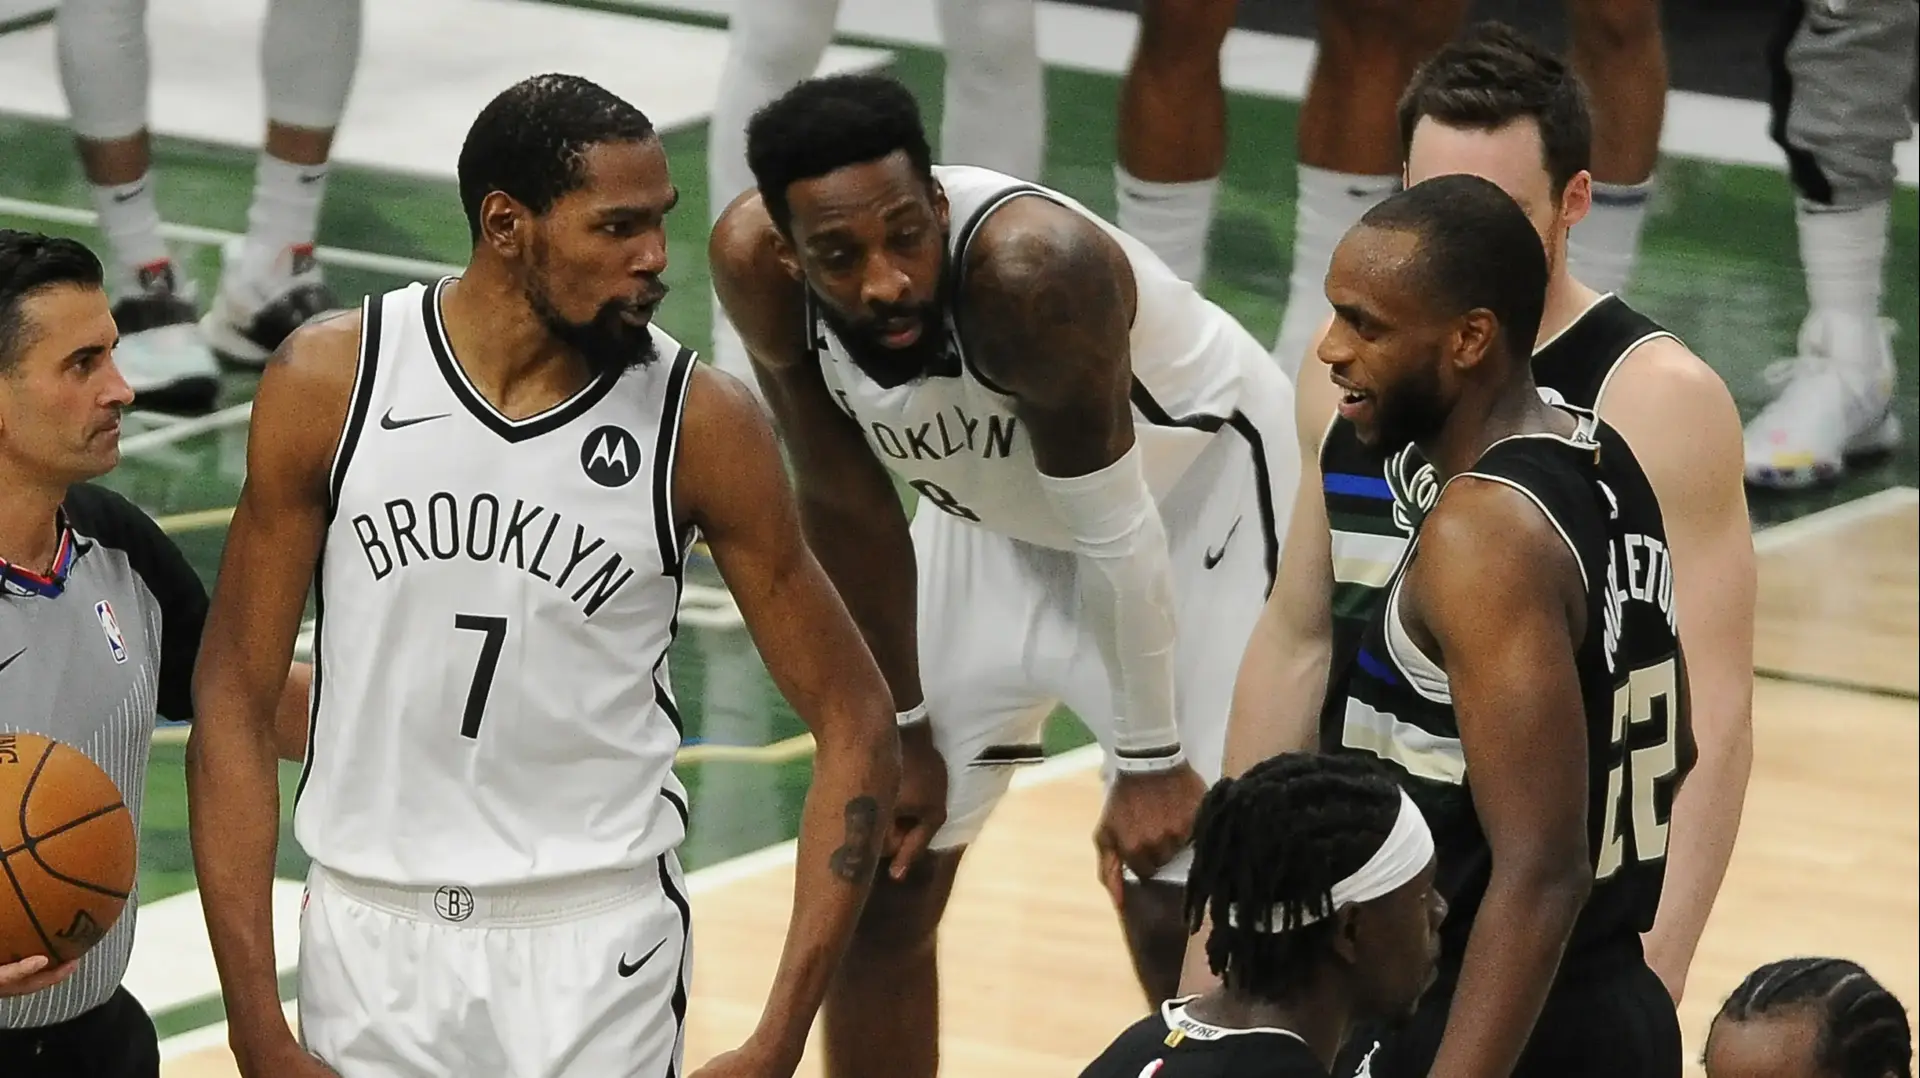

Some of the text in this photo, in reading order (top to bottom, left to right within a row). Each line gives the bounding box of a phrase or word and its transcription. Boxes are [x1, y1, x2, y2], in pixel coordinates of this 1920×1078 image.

[835, 389, 1016, 460] OKLYN
[352, 491, 635, 618] BROOKLYN
[454, 613, 508, 739] 7
